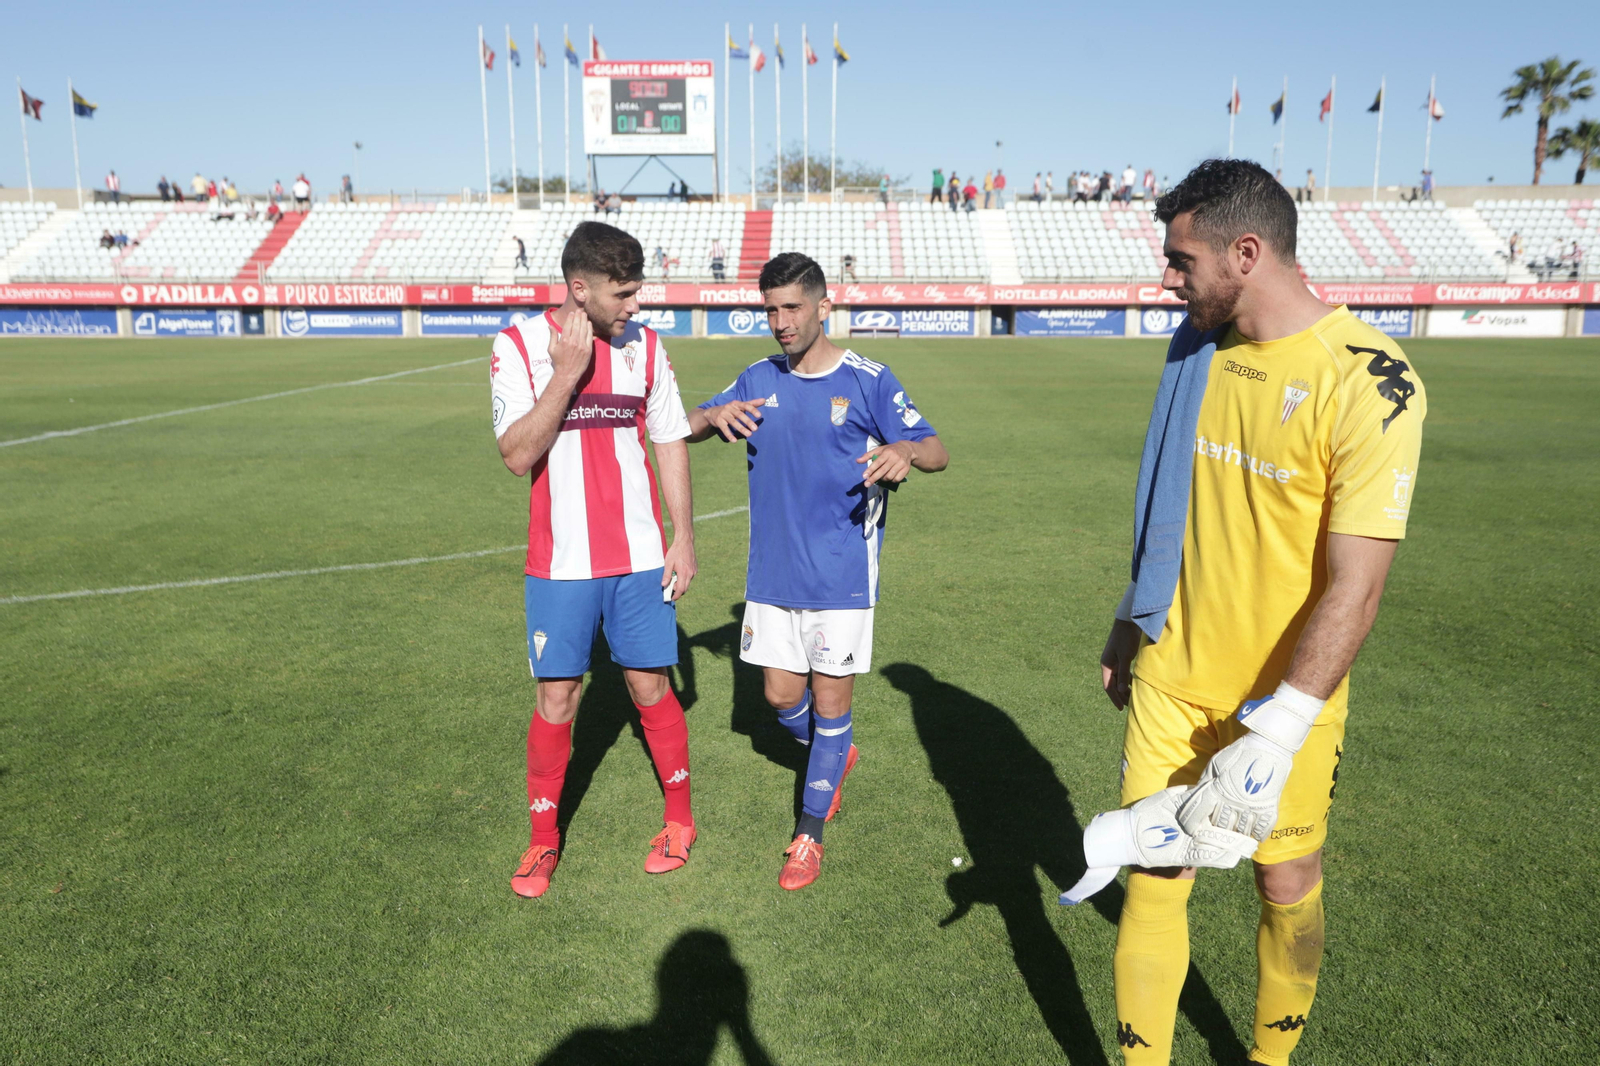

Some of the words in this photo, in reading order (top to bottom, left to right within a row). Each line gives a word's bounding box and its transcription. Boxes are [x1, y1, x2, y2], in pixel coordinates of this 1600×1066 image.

[593, 63, 640, 76] GIGANTE
[650, 61, 709, 76] EMPEÑOS
[615, 103, 639, 111] LOCAL
[661, 115, 681, 132] 00
[142, 284, 238, 304] PADILLA
[285, 284, 329, 305] PURO
[334, 284, 404, 305] ESTRECHO
[472, 286, 536, 298] Socialistas
[994, 289, 1057, 300] HOTELES
[1060, 286, 1128, 300] ALBORÁN
[1326, 292, 1361, 303] AGUA
[1363, 292, 1414, 303] MARINA
[1435, 284, 1522, 302] Cruzcampo
[423, 315, 471, 326] Grazalema
[473, 315, 502, 326] Motor
[902, 310, 969, 321] HYUNDAI
[1488, 315, 1527, 326] Vopak
[2, 319, 112, 335] Manhattan
[902, 321, 969, 332] PERMOTOR
[1224, 360, 1267, 381] Kappa
[562, 404, 637, 421] asterhouse
[1271, 824, 1315, 839] Kappa
